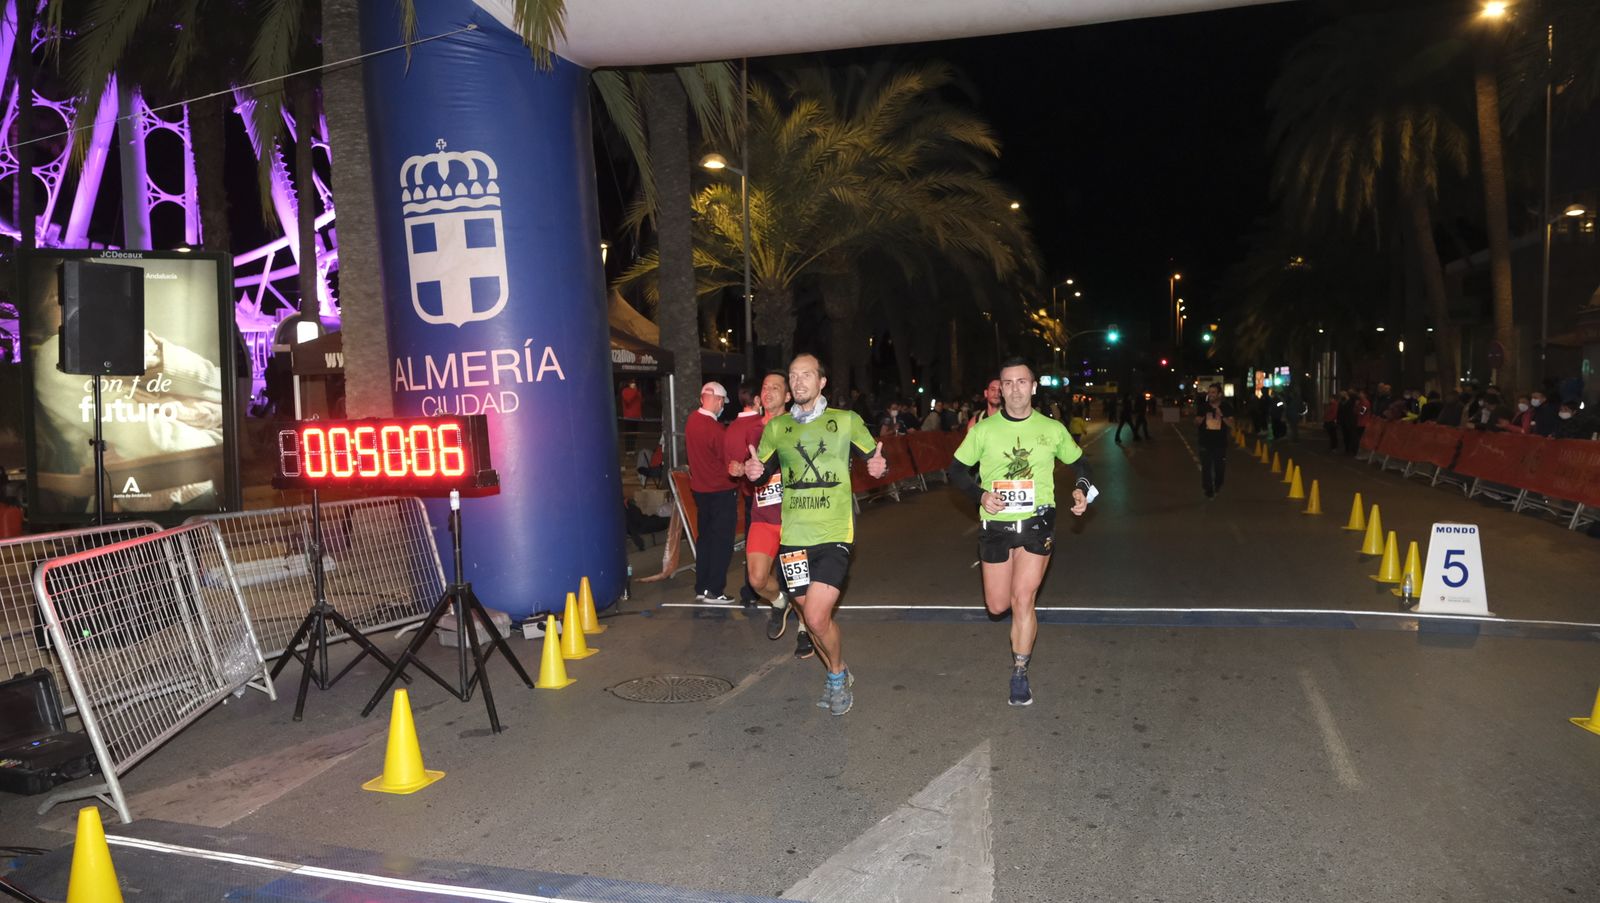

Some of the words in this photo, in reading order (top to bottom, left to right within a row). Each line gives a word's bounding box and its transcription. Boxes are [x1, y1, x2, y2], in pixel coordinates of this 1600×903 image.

[100, 251, 143, 259] JCDecaux
[395, 338, 566, 392] ALMERÍA
[146, 372, 172, 393] de
[78, 395, 178, 423] futuro
[421, 391, 519, 417] CIUDAD
[303, 423, 465, 478] 00:50:06
[1000, 490, 1027, 502] 580
[1436, 526, 1476, 534] MONDO
[787, 561, 809, 576] 553
[1441, 549, 1469, 588] 5
